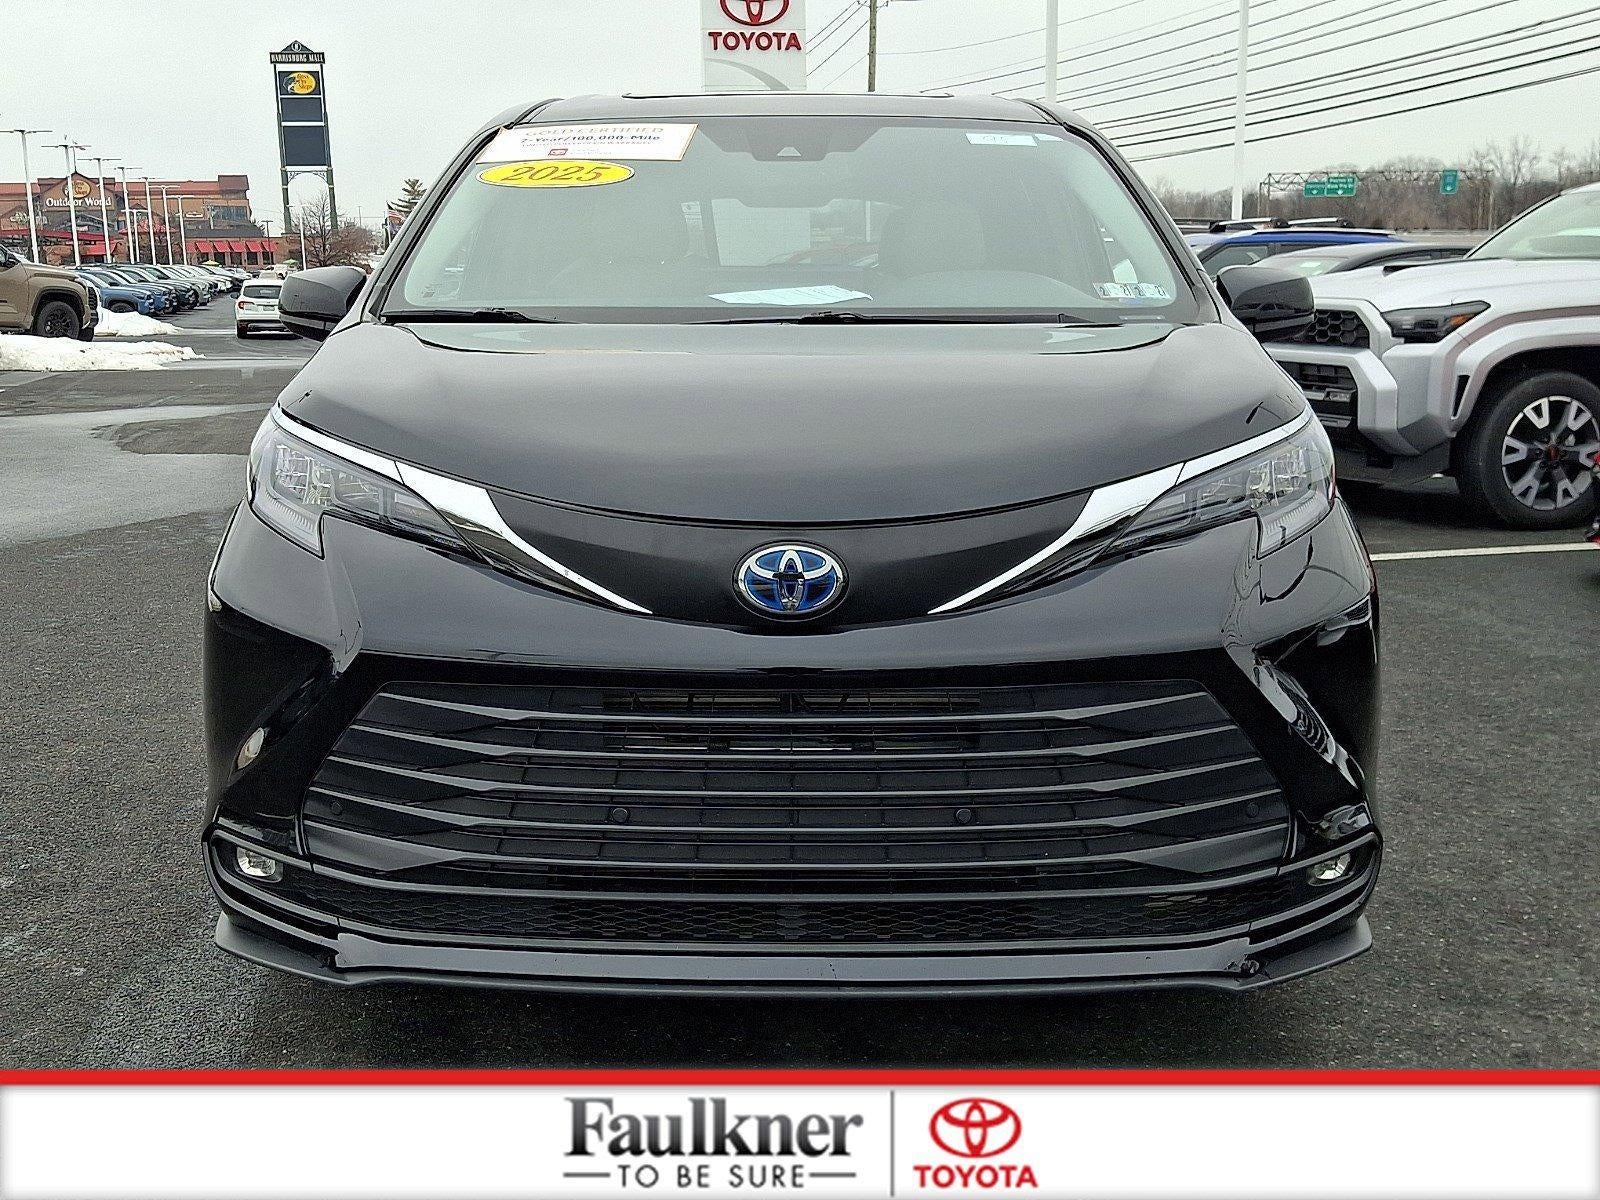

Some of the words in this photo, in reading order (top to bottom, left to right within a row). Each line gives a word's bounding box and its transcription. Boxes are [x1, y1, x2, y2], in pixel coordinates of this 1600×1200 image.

[708, 31, 802, 51] TOYOTA
[308, 53, 323, 62] MALL
[500, 165, 611, 182] 2025
